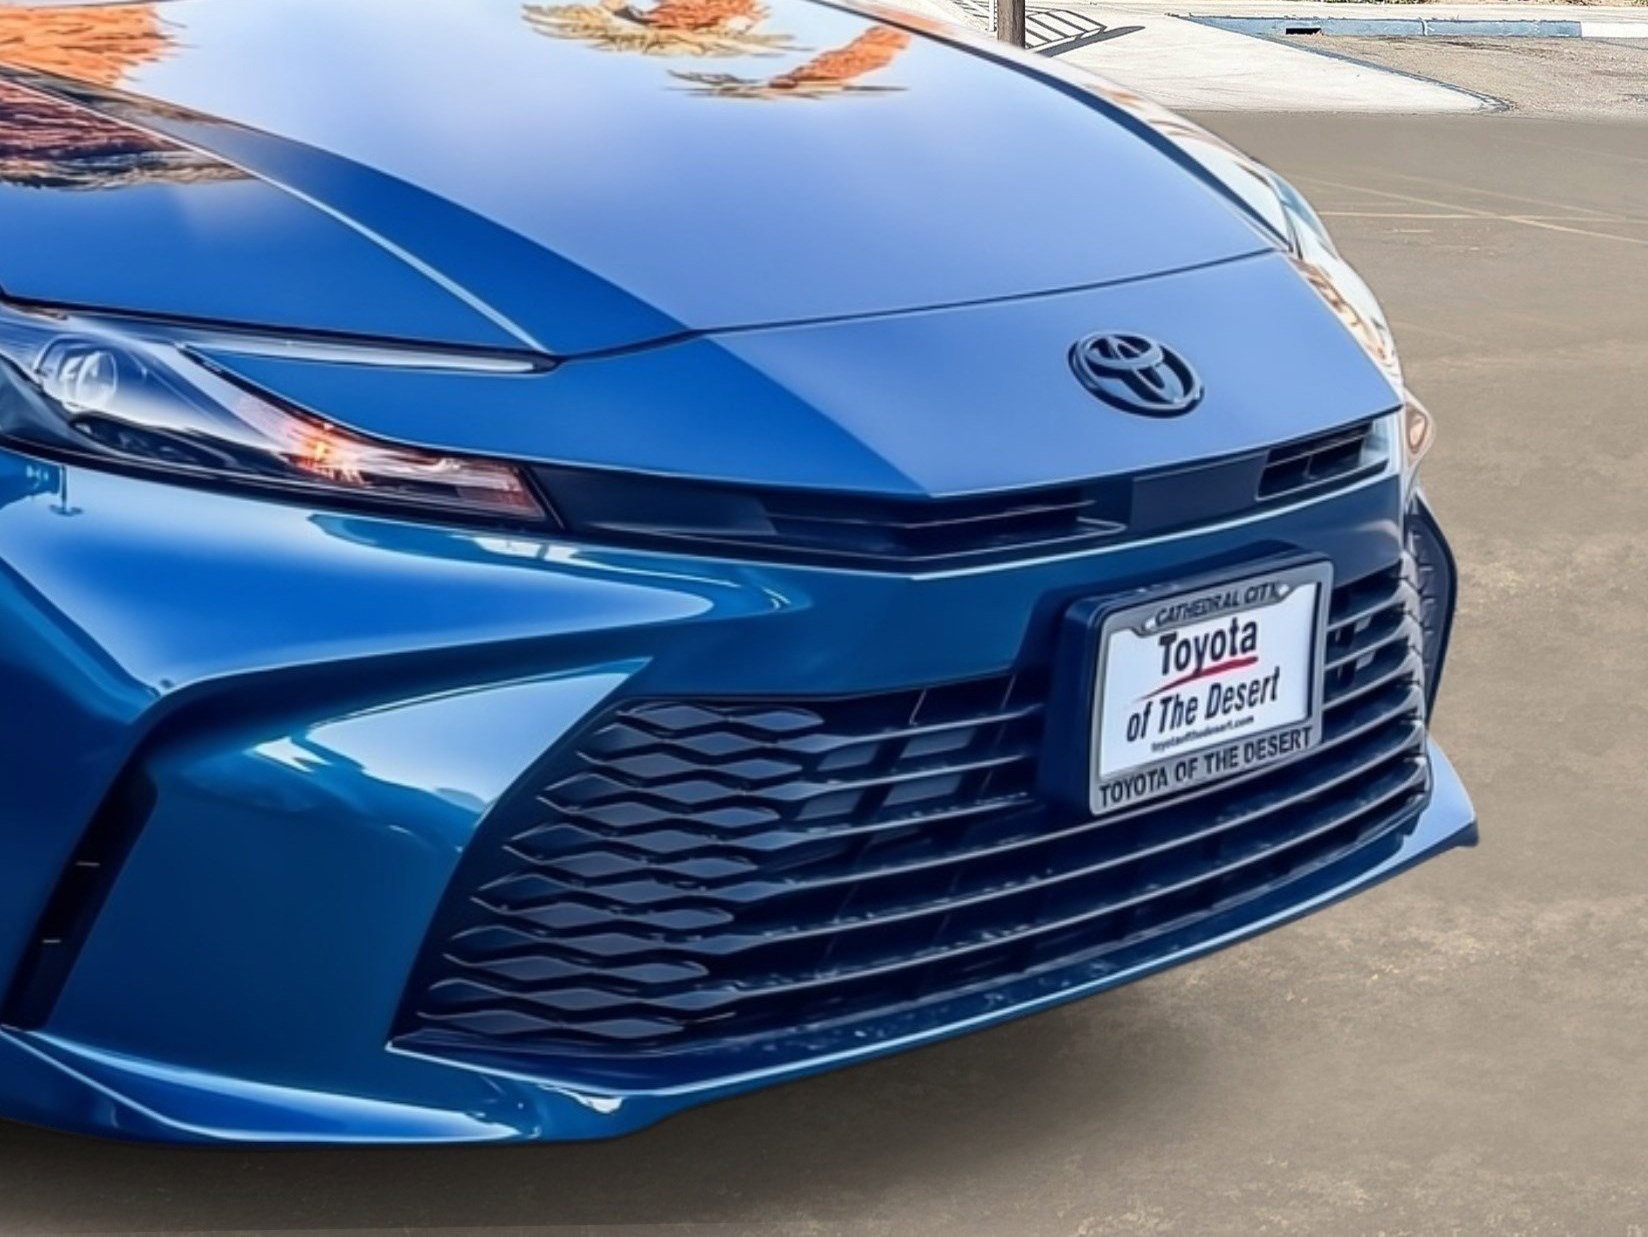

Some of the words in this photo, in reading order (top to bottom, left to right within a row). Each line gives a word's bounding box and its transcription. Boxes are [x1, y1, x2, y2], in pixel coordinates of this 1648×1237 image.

[1155, 590, 1240, 626] CATHEDRAL
[1158, 617, 1258, 677] Toyota
[1126, 701, 1153, 742] of
[1158, 694, 1198, 734] The
[1204, 667, 1280, 719] Desert
[1099, 769, 1168, 808] TOYOTA
[1175, 757, 1199, 783] OF
[1203, 745, 1239, 775] THE
[1243, 726, 1313, 763] DESERT
